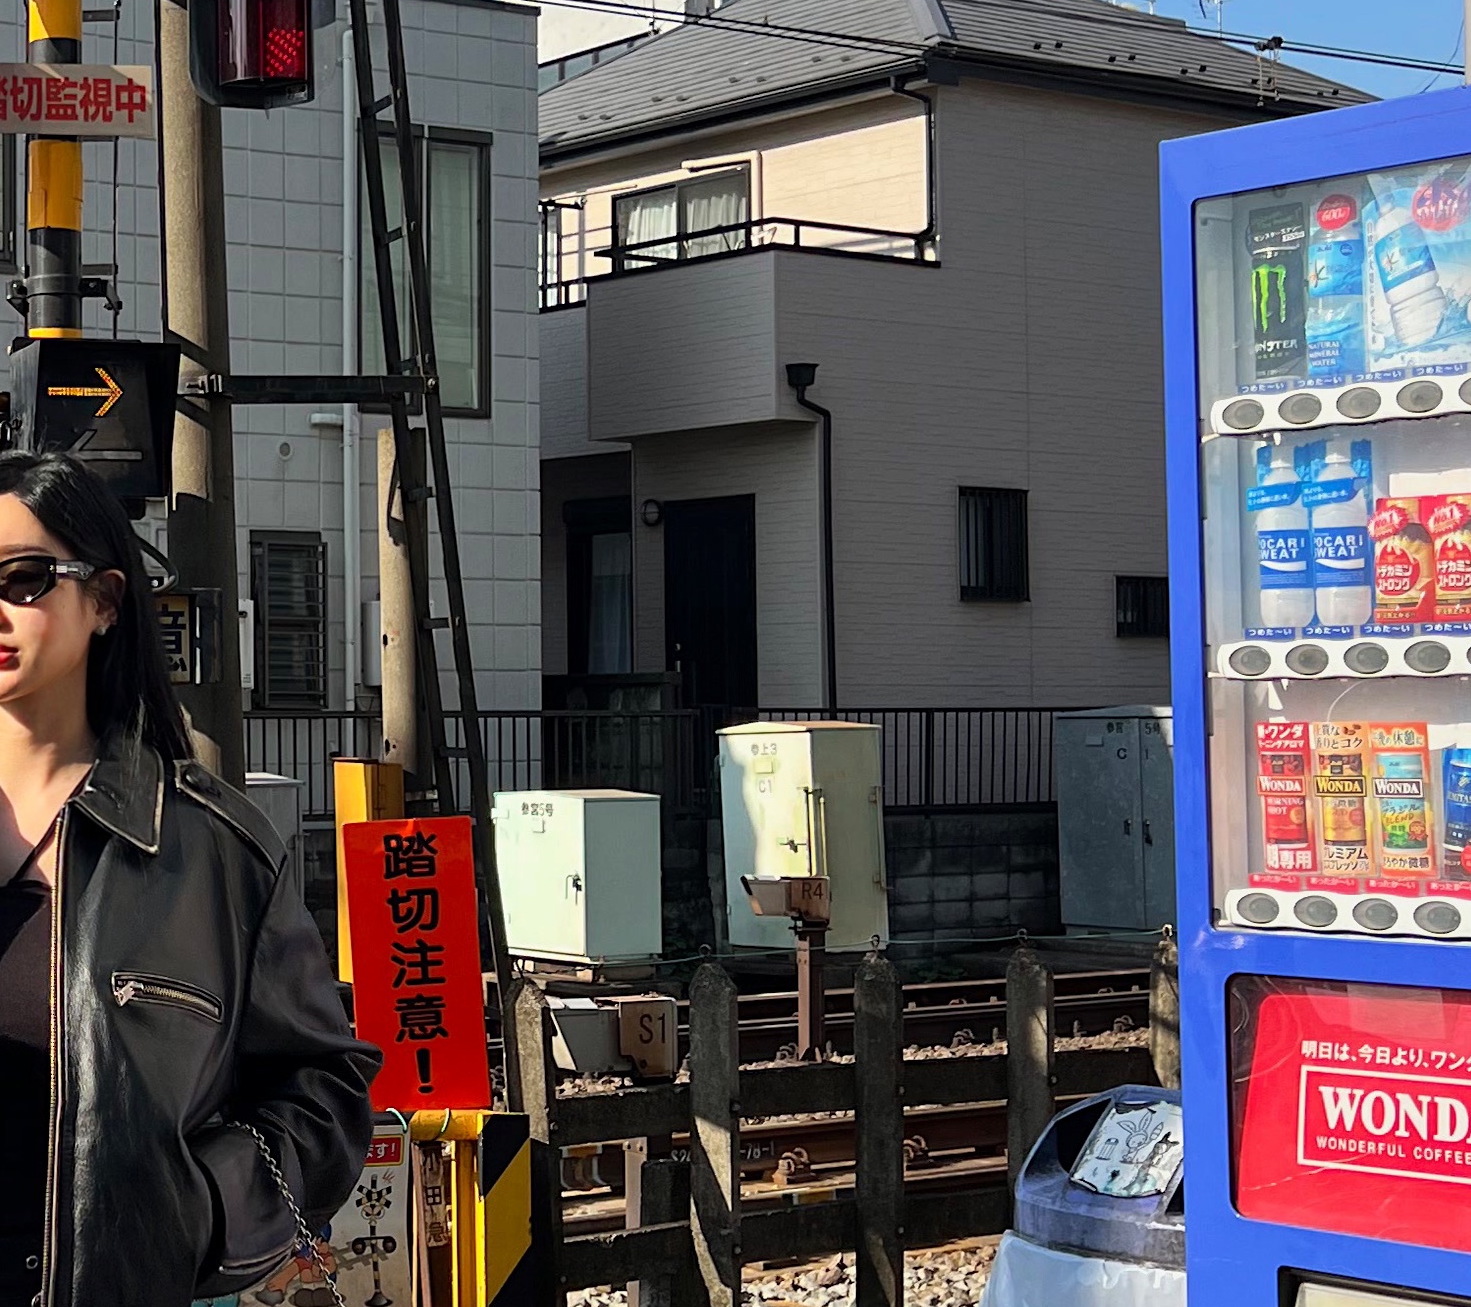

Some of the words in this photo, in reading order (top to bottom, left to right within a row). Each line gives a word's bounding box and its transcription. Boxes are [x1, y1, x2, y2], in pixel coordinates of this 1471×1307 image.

[1258, 537, 1305, 549] OCARI
[1259, 548, 1299, 560] WEAT
[1117, 748, 1127, 759] C
[759, 779, 772, 794] C1
[1260, 777, 1301, 792] WONDA
[1316, 776, 1362, 793] WONDA
[1375, 779, 1419, 794] WONDA
[802, 883, 823, 900] R4
[383, 831, 449, 1094] 踏切注意!
[639, 1013, 666, 1044] S1
[1318, 1086, 1471, 1143] WOND
[1316, 1136, 1406, 1157] WONDERFUL
